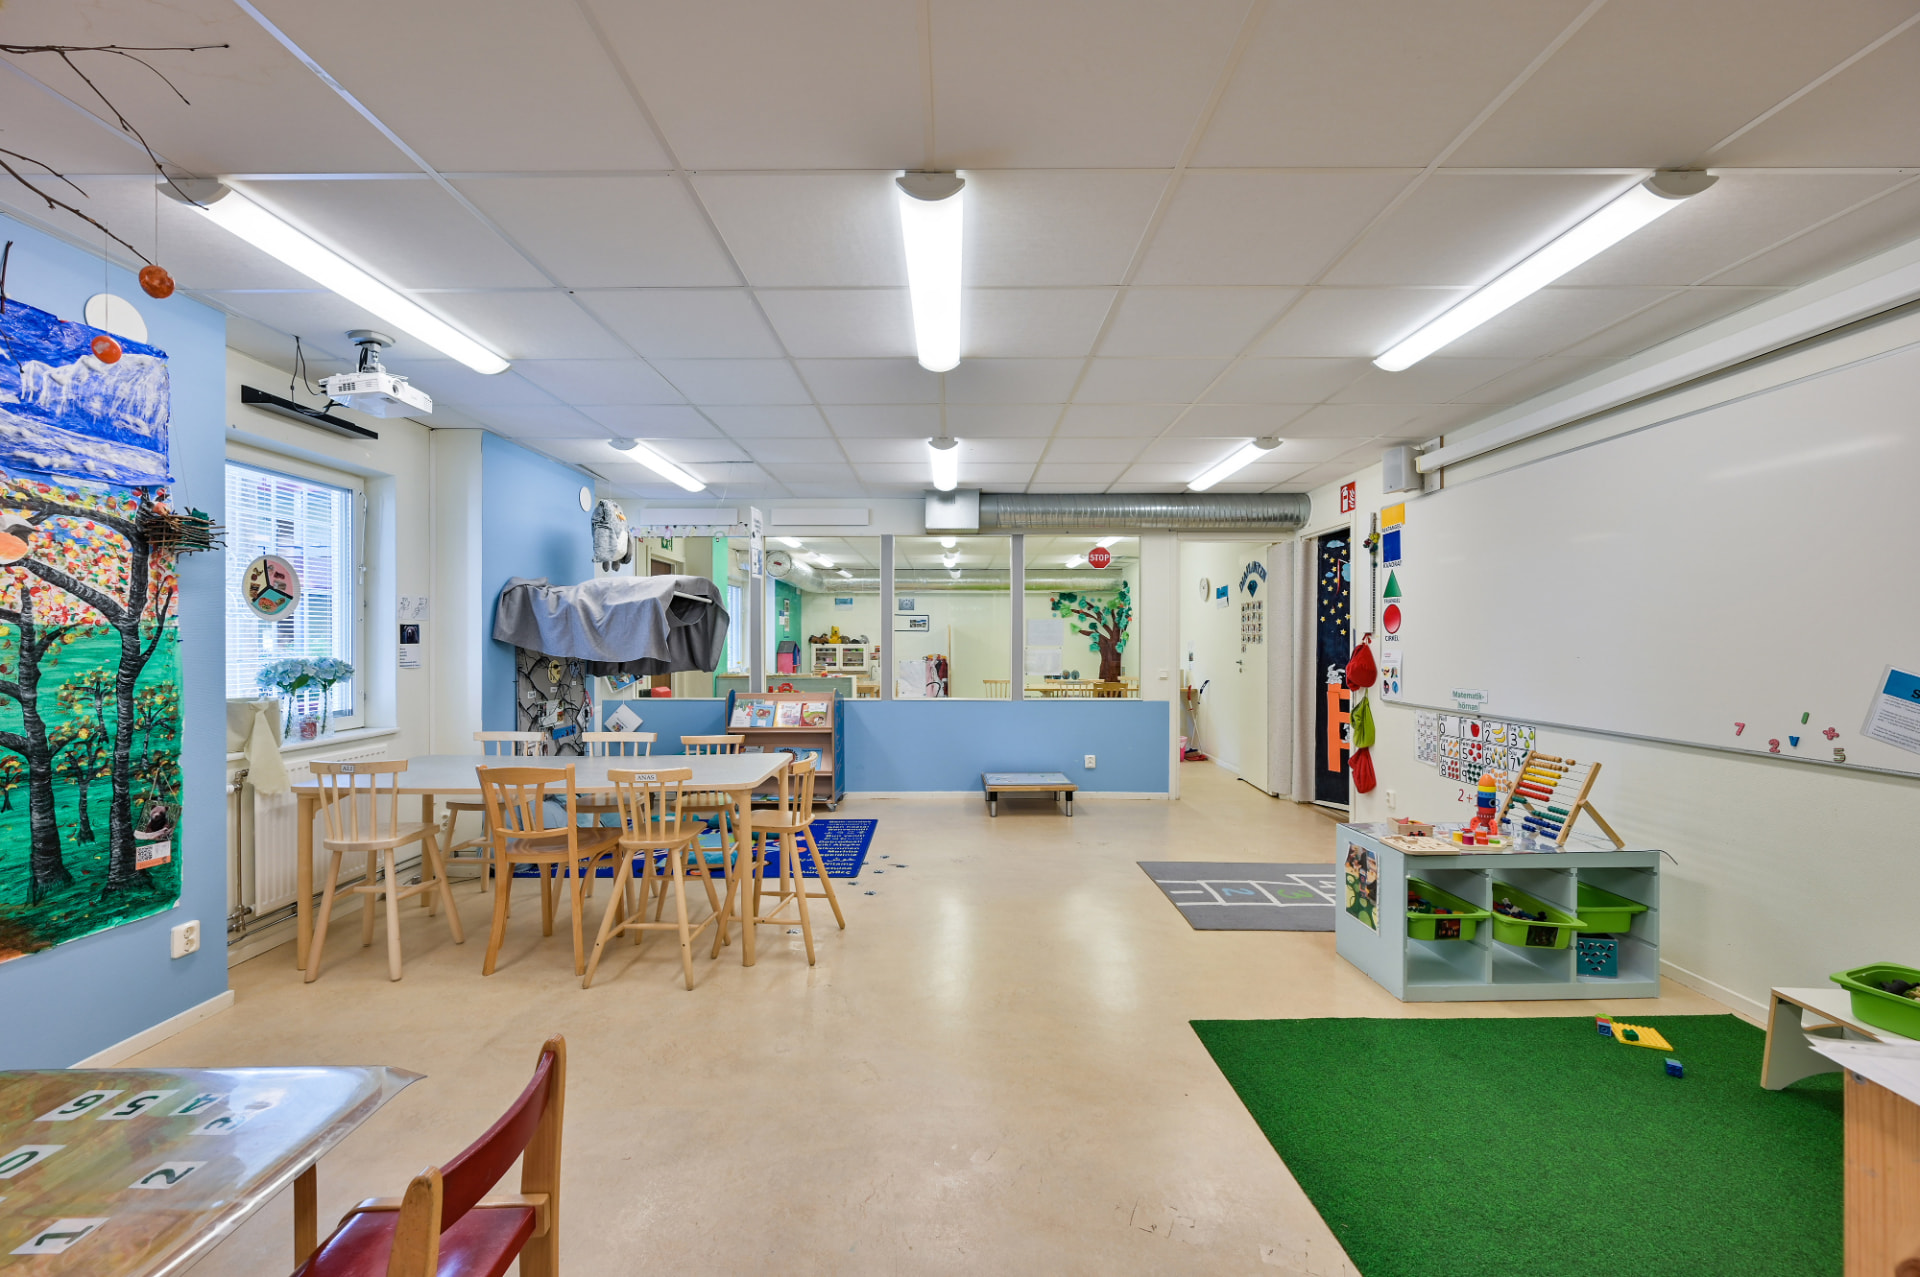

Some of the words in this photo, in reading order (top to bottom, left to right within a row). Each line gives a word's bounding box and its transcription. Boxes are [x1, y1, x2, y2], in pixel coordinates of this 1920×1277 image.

[1383, 560, 1402, 568] KVADRAT
[1734, 722, 1746, 736] 7
[1485, 730, 1492, 742] 2
[1511, 733, 1517, 746] 3
[1441, 744, 1446, 755] 4
[1768, 739, 1780, 753] 2
[1462, 748, 1468, 760] 5
[1485, 752, 1491, 765] 6
[1833, 748, 1846, 763] 5
[1511, 758, 1516, 769] 7
[1441, 764, 1446, 776] 8
[1458, 788, 1464, 802] 2
[1220, 888, 1256, 896] 2
[1276, 889, 1314, 899] 3
[113, 1096, 160, 1116] 5
[140, 1166, 195, 1184] 2
